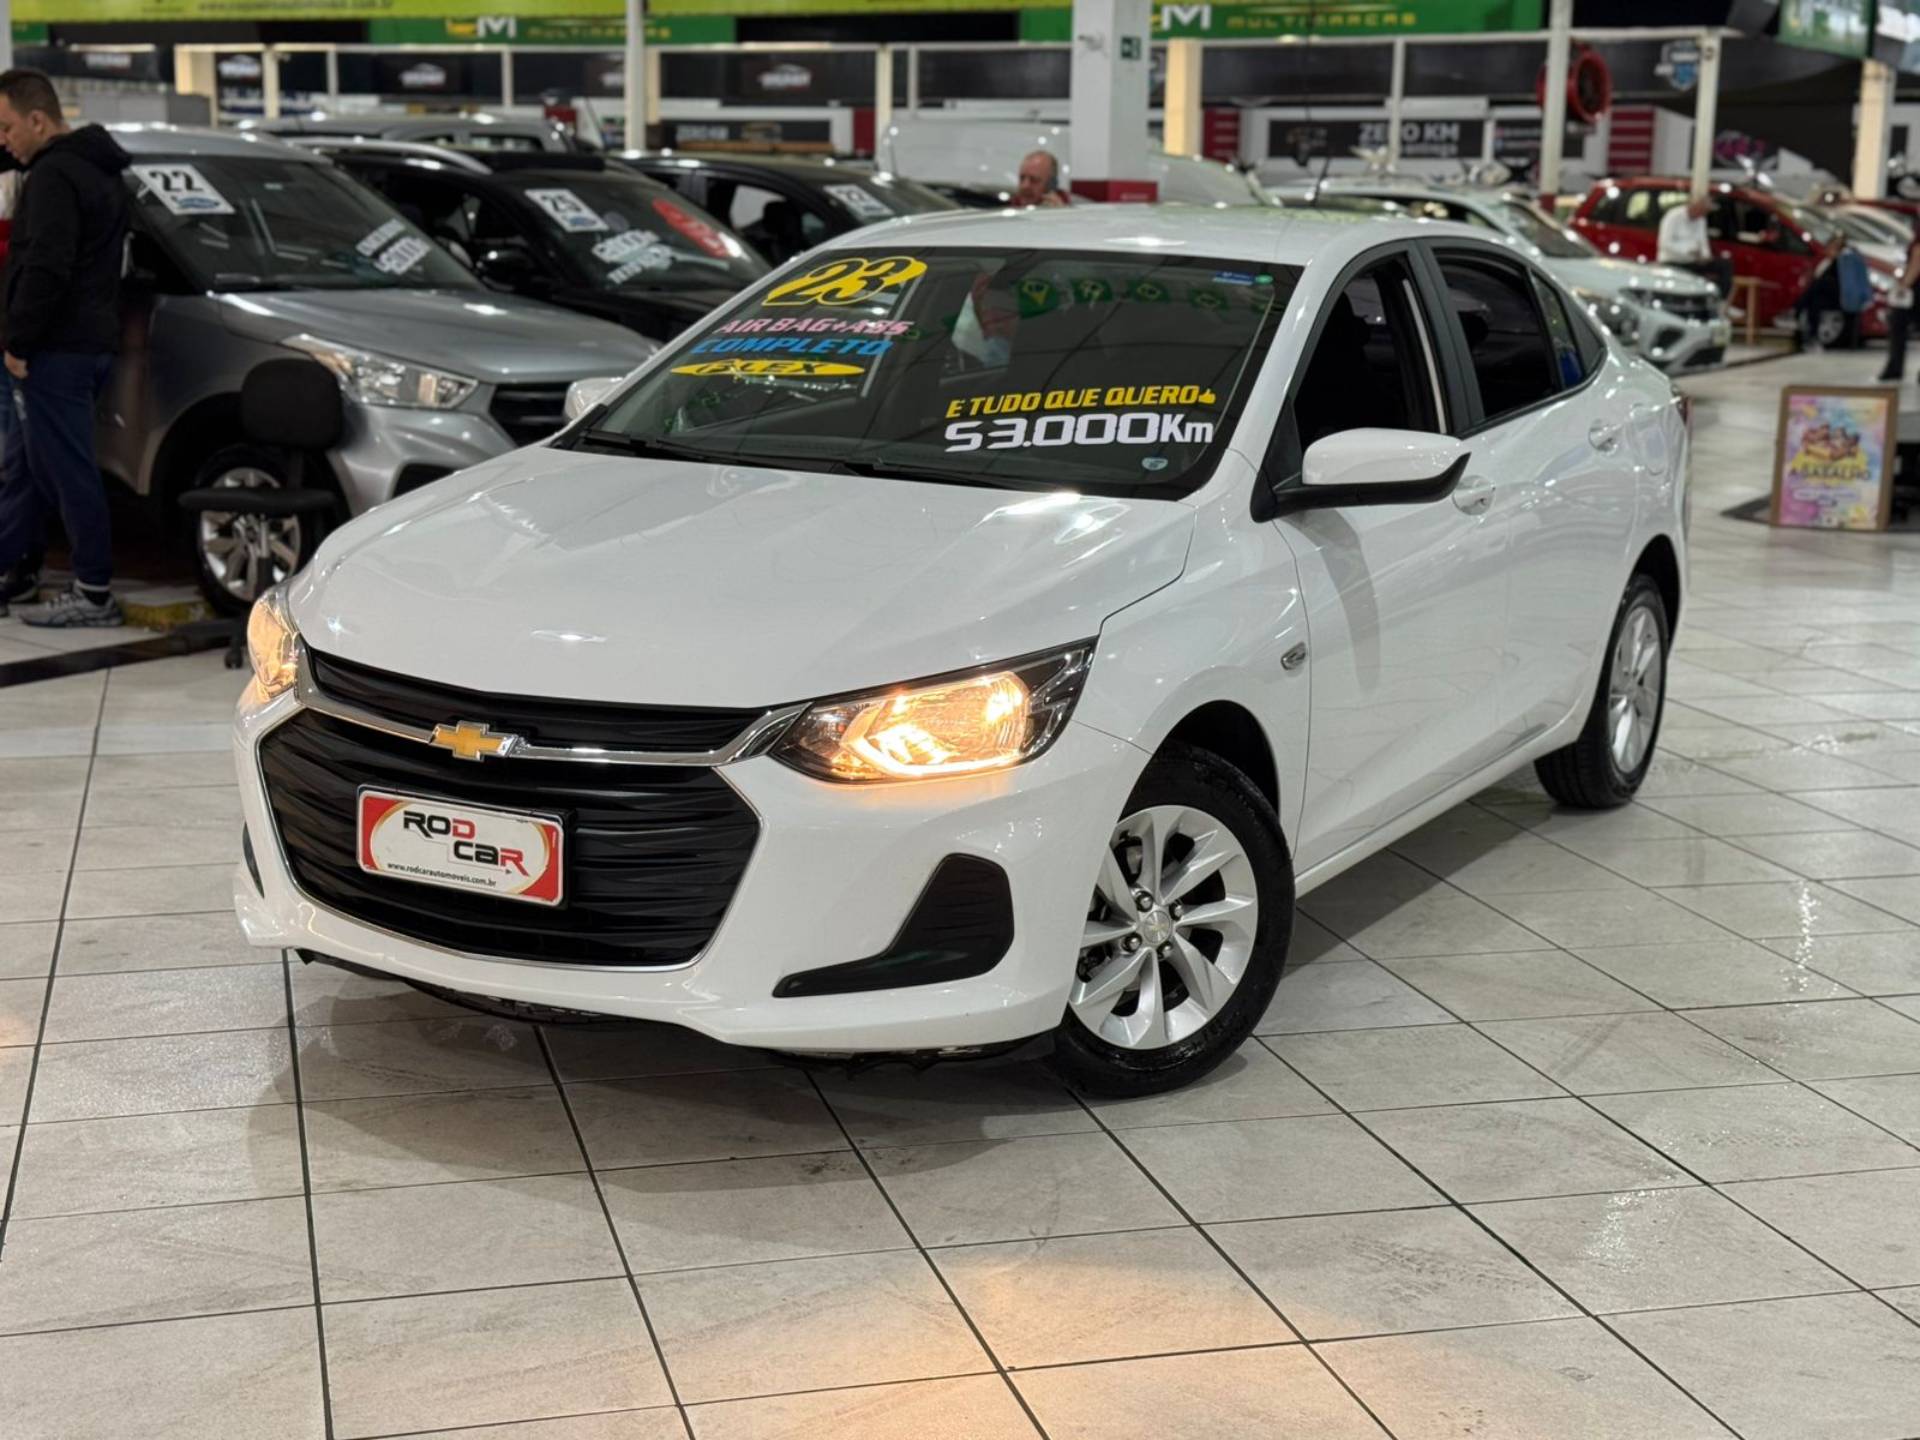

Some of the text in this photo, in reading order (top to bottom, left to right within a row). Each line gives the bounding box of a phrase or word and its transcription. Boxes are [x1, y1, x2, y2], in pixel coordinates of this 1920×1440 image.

[761, 256, 928, 307] 23
[690, 338, 893, 355] COMPLETO
[696, 359, 824, 374] FLEX
[969, 393, 1042, 416] TUDO
[1044, 388, 1101, 410] QUE
[1104, 385, 1200, 407] QUERO
[403, 810, 475, 839] ROD
[387, 863, 496, 887] www.rodcarautomoveis.com.br
